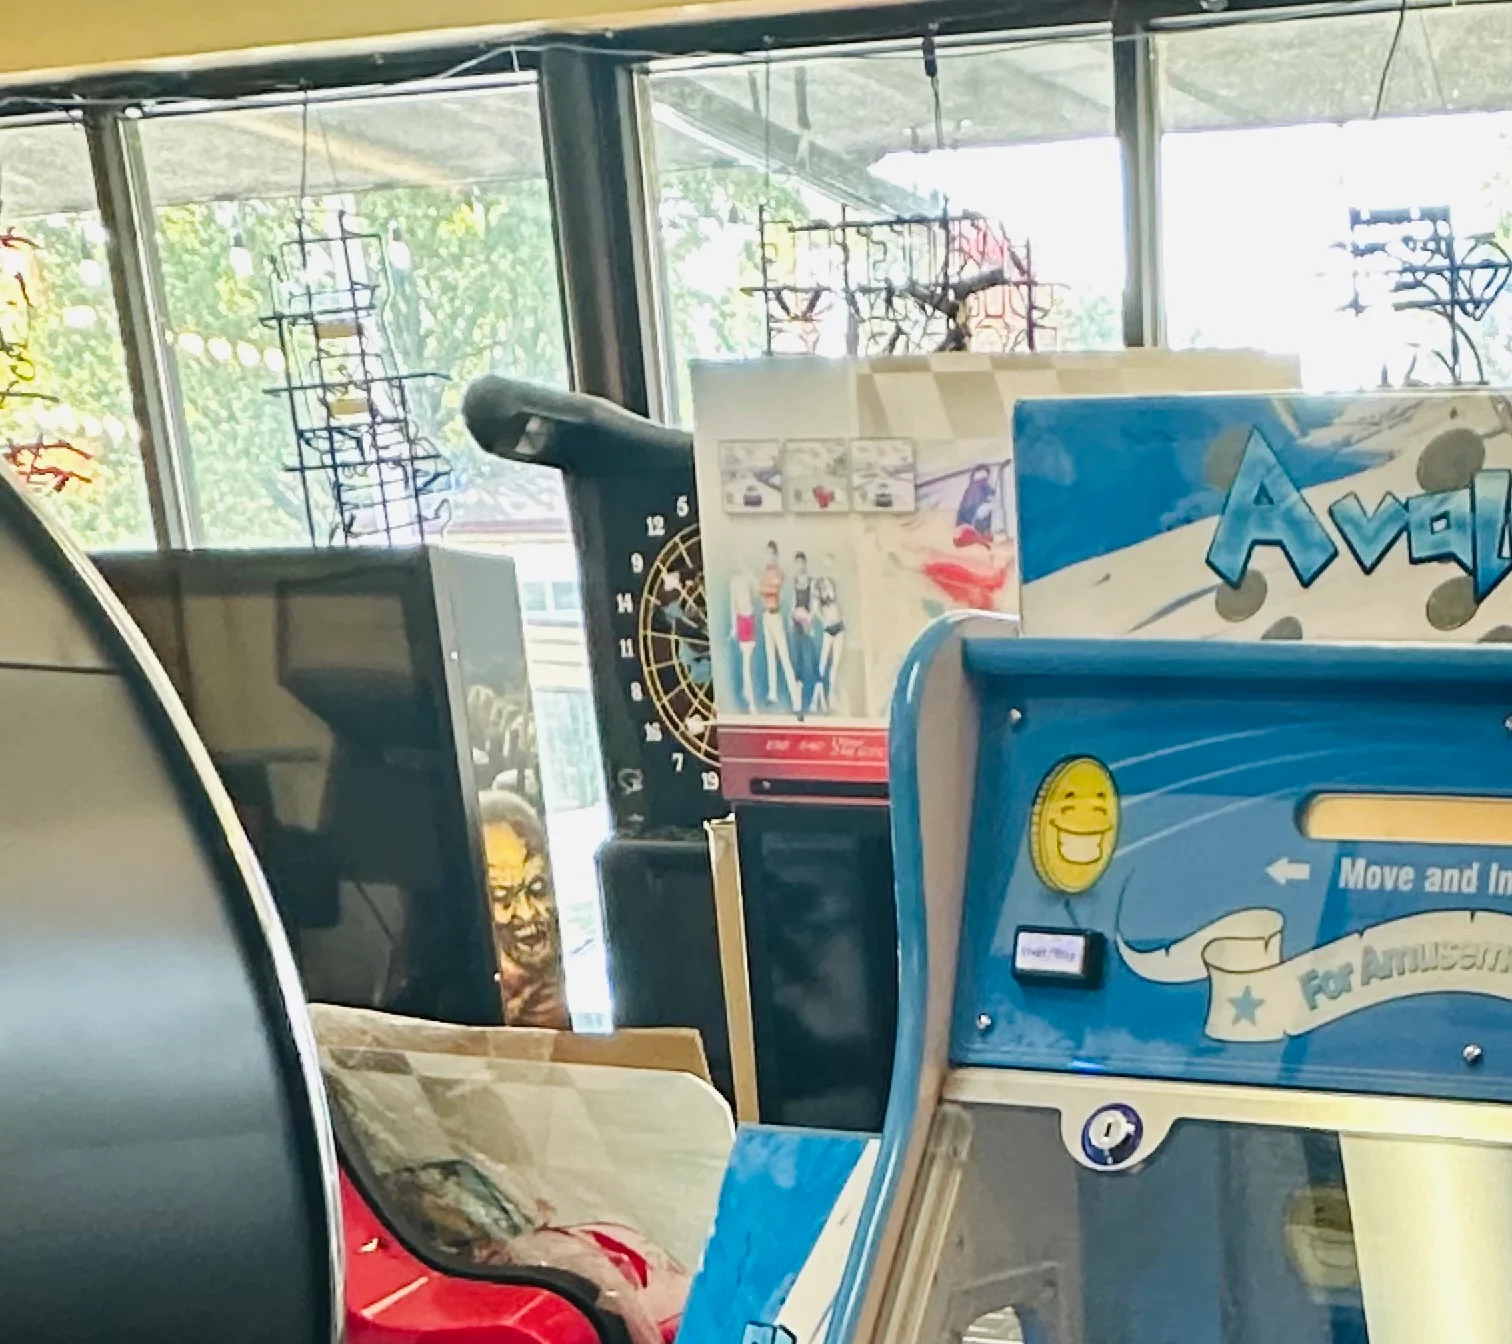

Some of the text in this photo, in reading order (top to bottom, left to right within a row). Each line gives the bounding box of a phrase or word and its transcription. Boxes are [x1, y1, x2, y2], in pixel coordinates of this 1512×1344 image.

[645, 514, 667, 538] 12
[630, 551, 644, 574] 9
[616, 592, 634, 614] 14
[618, 638, 635, 659] 11
[630, 680, 644, 702] 8
[643, 721, 662, 742] 16
[672, 752, 685, 773] 7
[700, 771, 720, 791] 19
[1338, 855, 1414, 892] Move
[1424, 860, 1480, 894] and
[1298, 957, 1355, 1011] For
